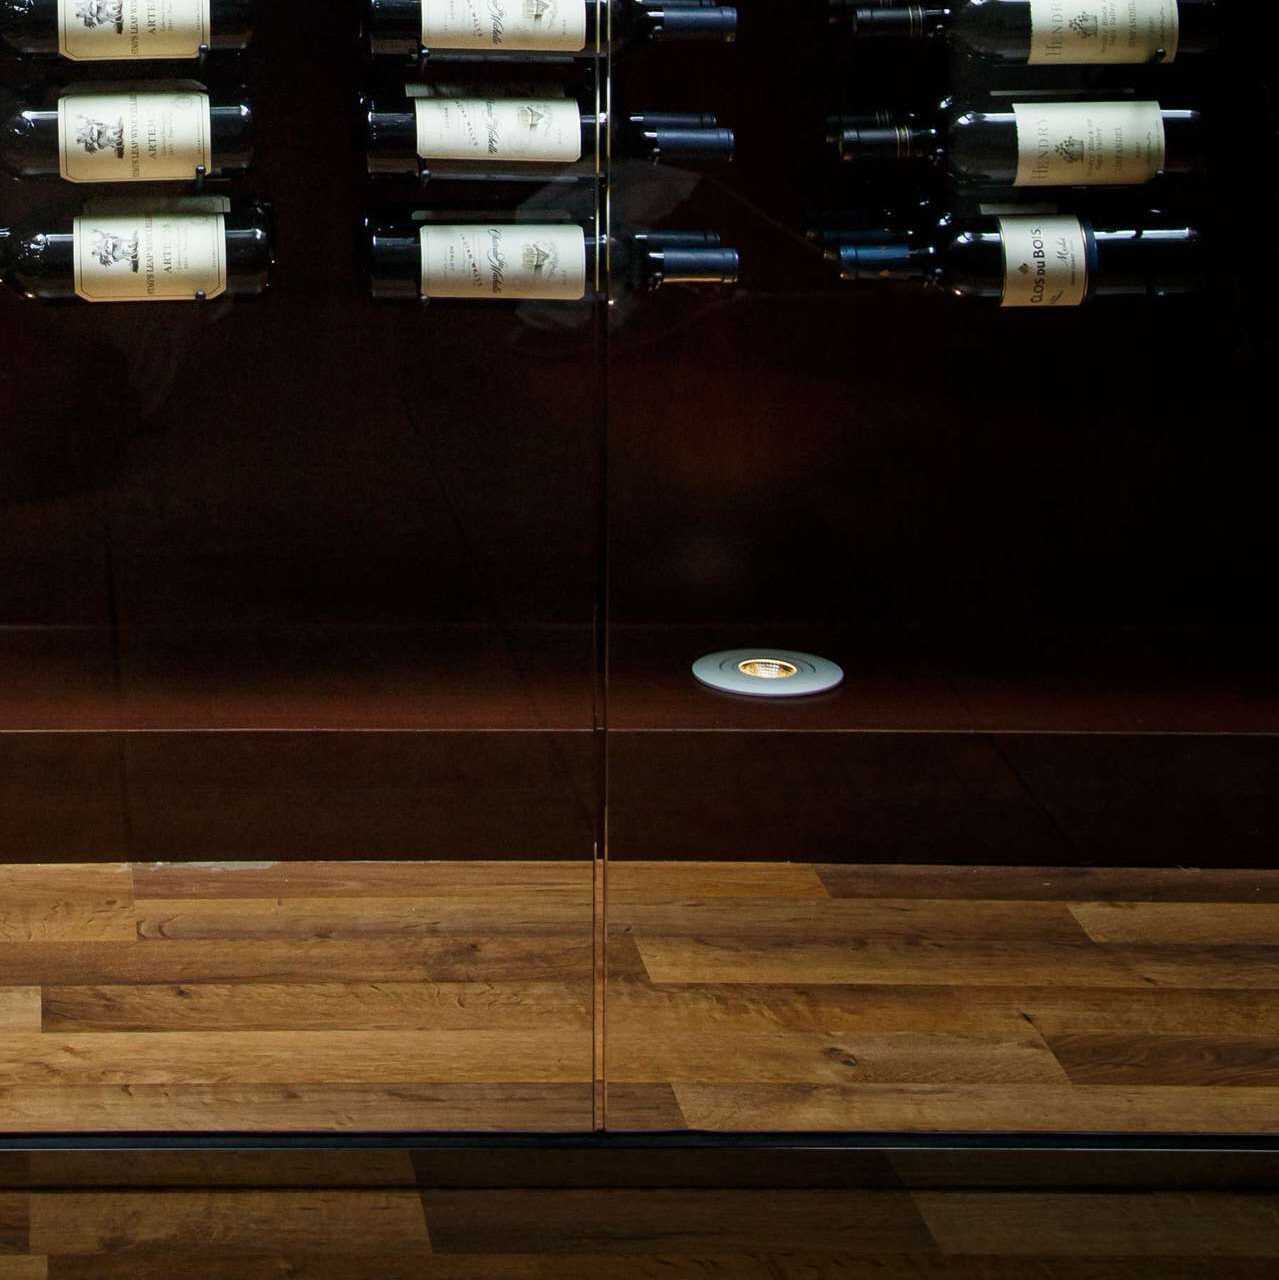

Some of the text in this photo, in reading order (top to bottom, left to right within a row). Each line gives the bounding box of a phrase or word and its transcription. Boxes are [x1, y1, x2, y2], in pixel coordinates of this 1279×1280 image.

[1031, 117, 1050, 181] HENDRY
[1029, 227, 1047, 304] CLOS DU BOIS
